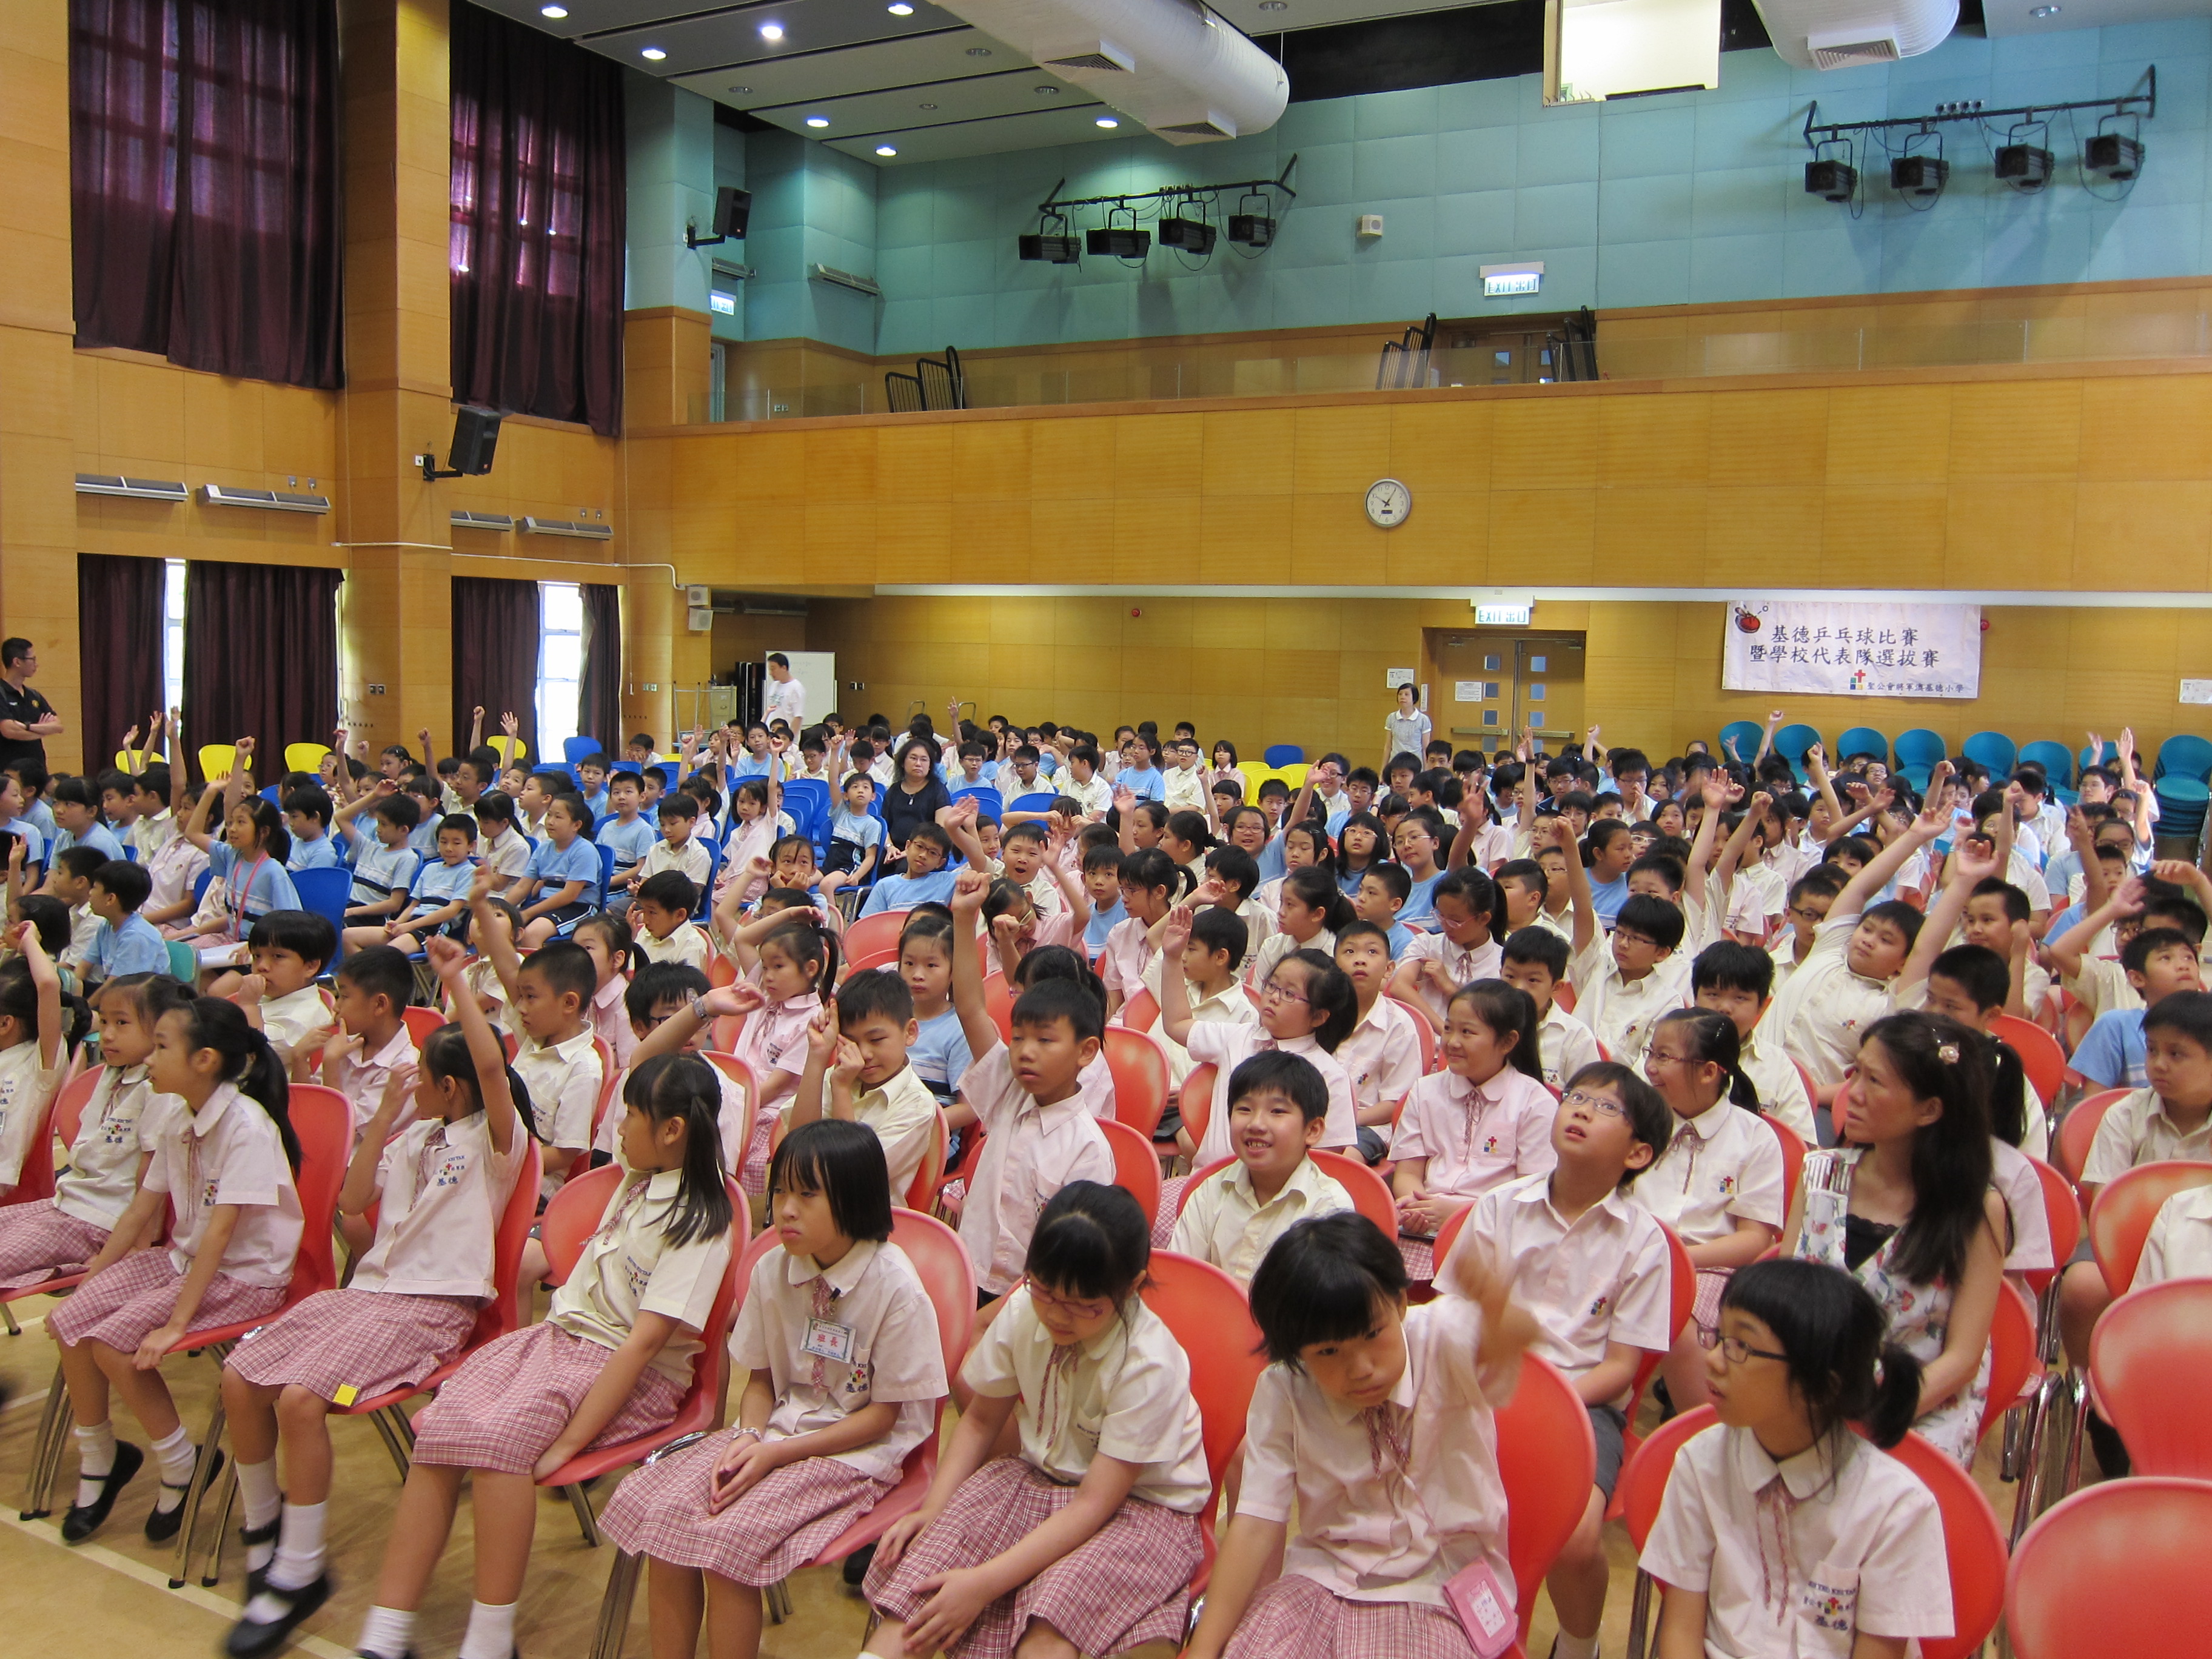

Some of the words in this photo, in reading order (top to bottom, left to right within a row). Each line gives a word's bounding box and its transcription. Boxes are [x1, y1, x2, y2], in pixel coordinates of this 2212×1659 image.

[1488, 281, 1511, 293] EXIT
[1516, 279, 1536, 292] 出口
[1478, 610, 1502, 622] EXIT
[1506, 610, 1526, 622] 出口
[1771, 625, 1919, 646] 基德乒乓球比賽
[1750, 645, 1939, 668] 暨學校代表隊選拔賽
[817, 1334, 838, 1347] 班長
